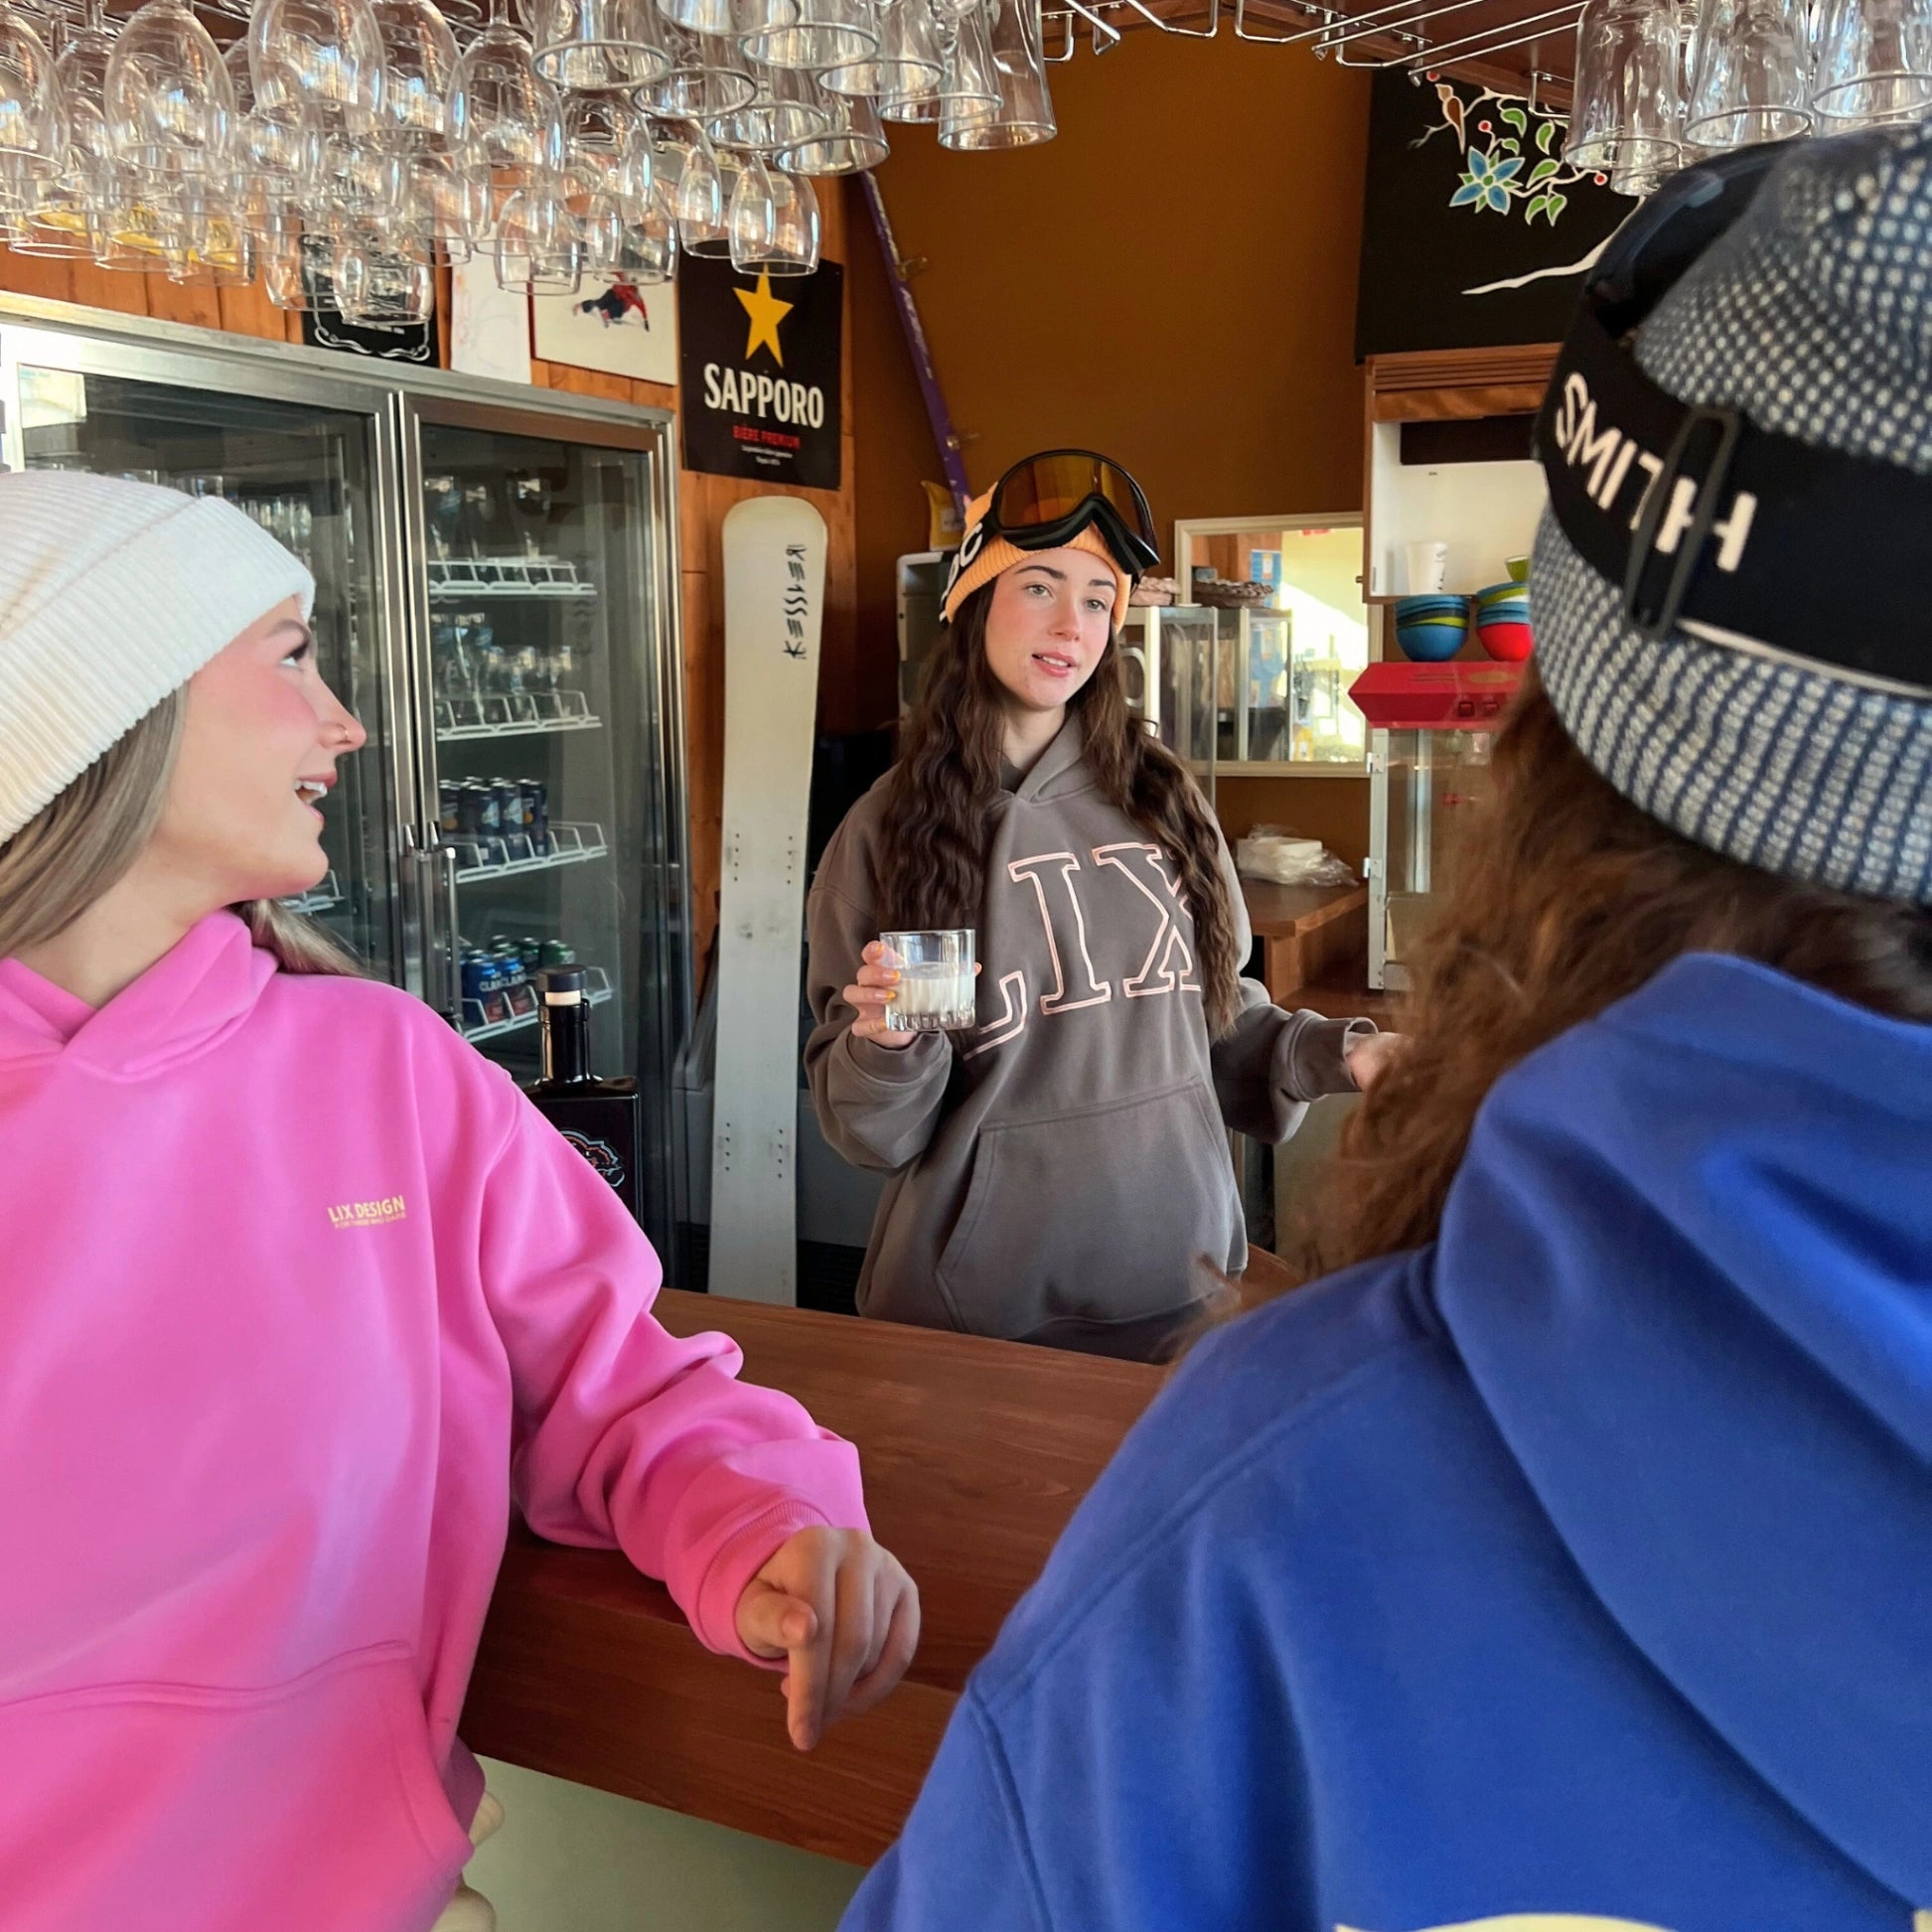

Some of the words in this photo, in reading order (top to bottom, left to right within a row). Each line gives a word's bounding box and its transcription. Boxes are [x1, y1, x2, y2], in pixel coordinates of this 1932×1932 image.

[703, 363, 824, 429] SAPPORO
[783, 543, 808, 660] KESSLER
[328, 1204, 355, 1223] LIX
[354, 1195, 405, 1219] DESIGN
